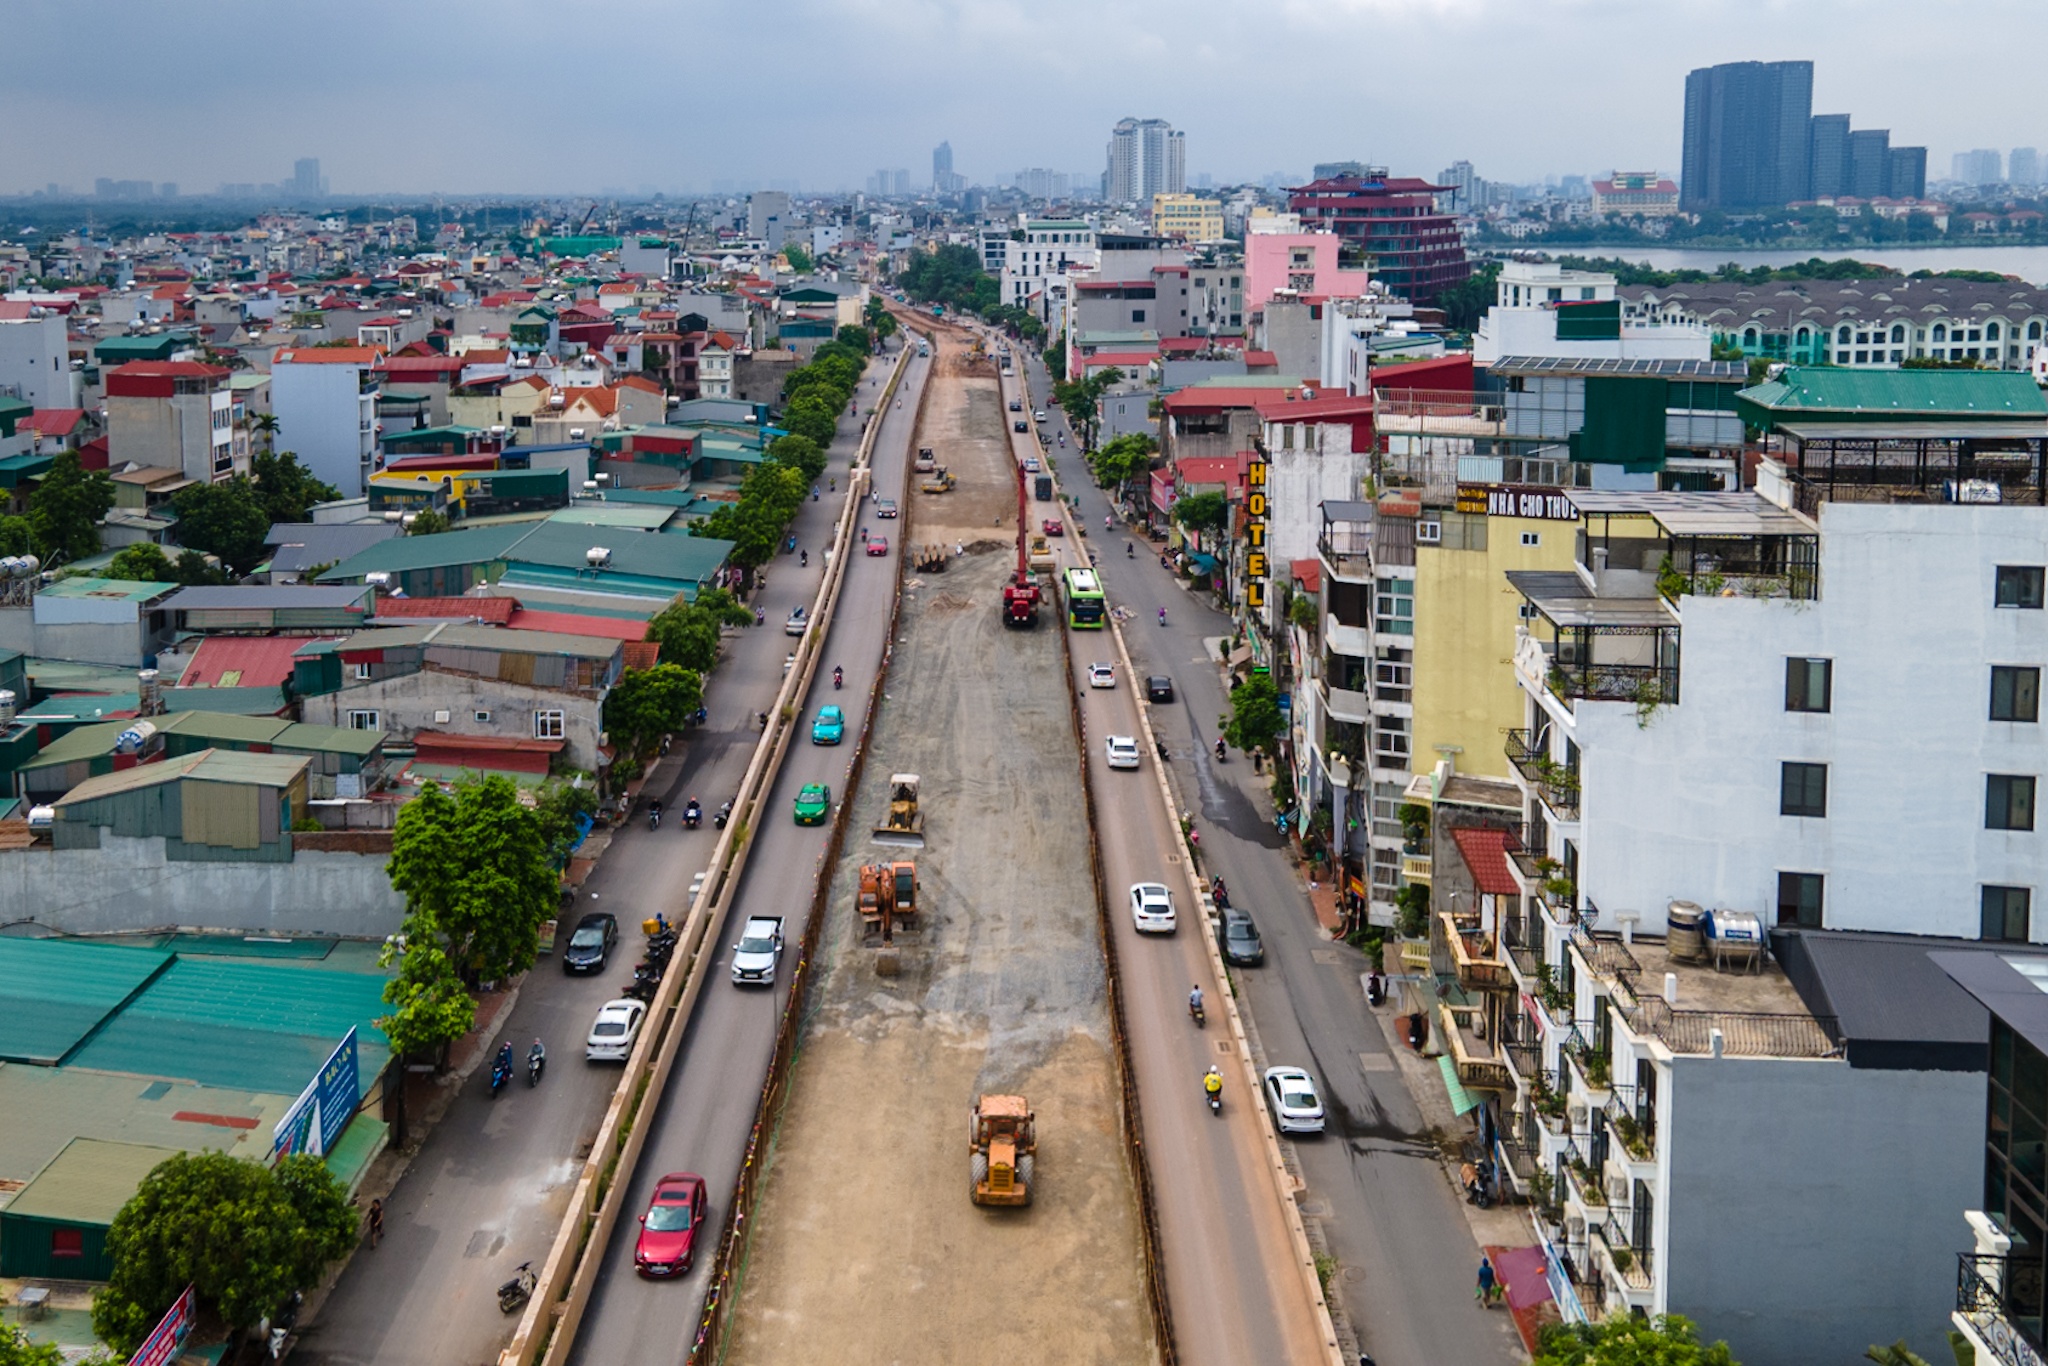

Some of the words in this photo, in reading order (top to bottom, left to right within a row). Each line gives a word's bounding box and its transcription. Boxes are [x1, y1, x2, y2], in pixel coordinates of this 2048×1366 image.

[1249, 463, 1266, 606] HOTEL
[1489, 488, 1515, 515] NHÀ
[1520, 494, 1544, 517] CHO
